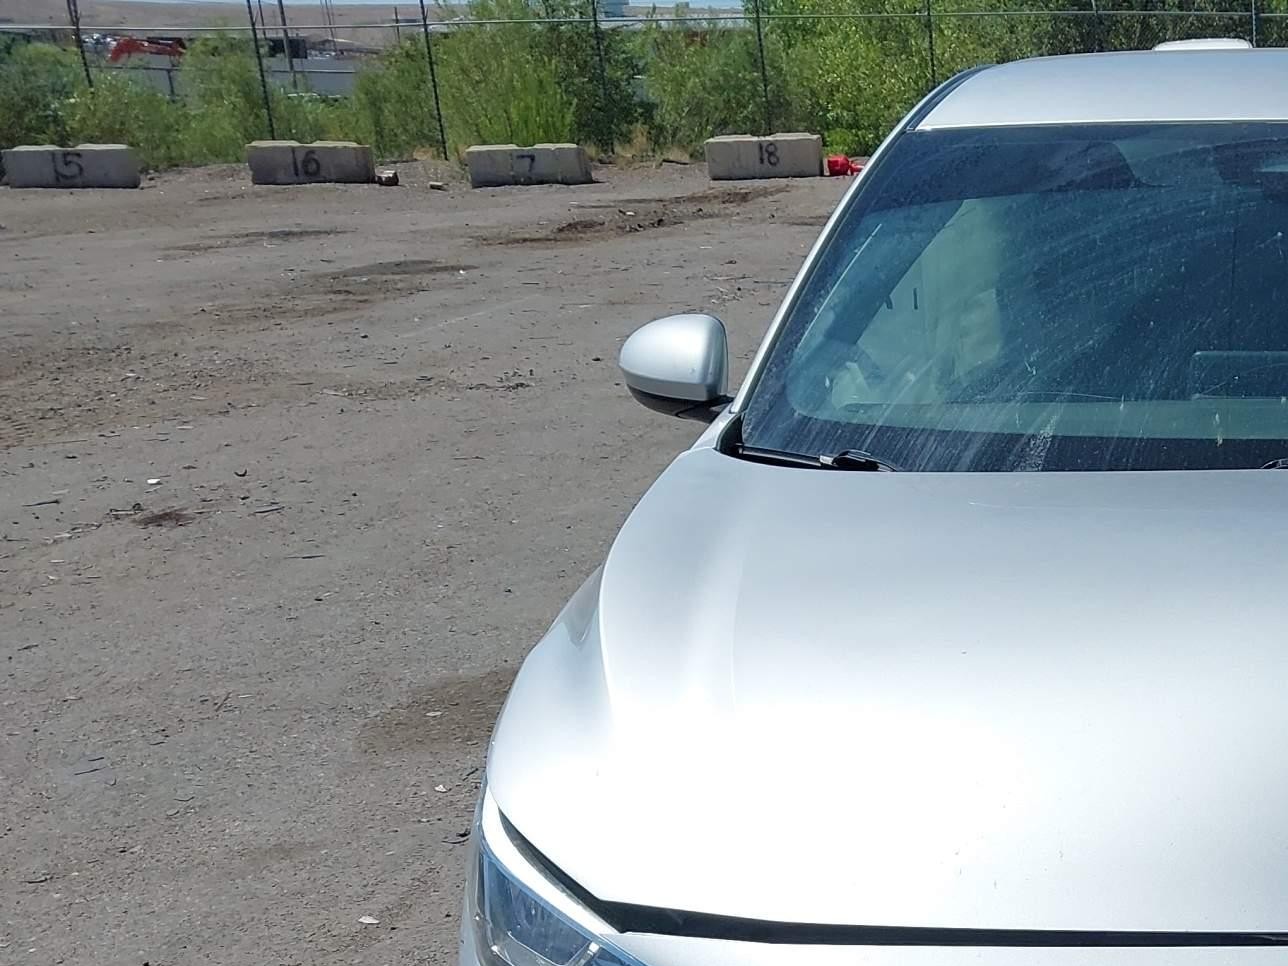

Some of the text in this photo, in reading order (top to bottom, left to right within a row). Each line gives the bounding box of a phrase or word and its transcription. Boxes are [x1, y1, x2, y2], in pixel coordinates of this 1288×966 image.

[51, 151, 84, 181] 15
[291, 147, 320, 176] 16
[758, 142, 780, 166] 18
